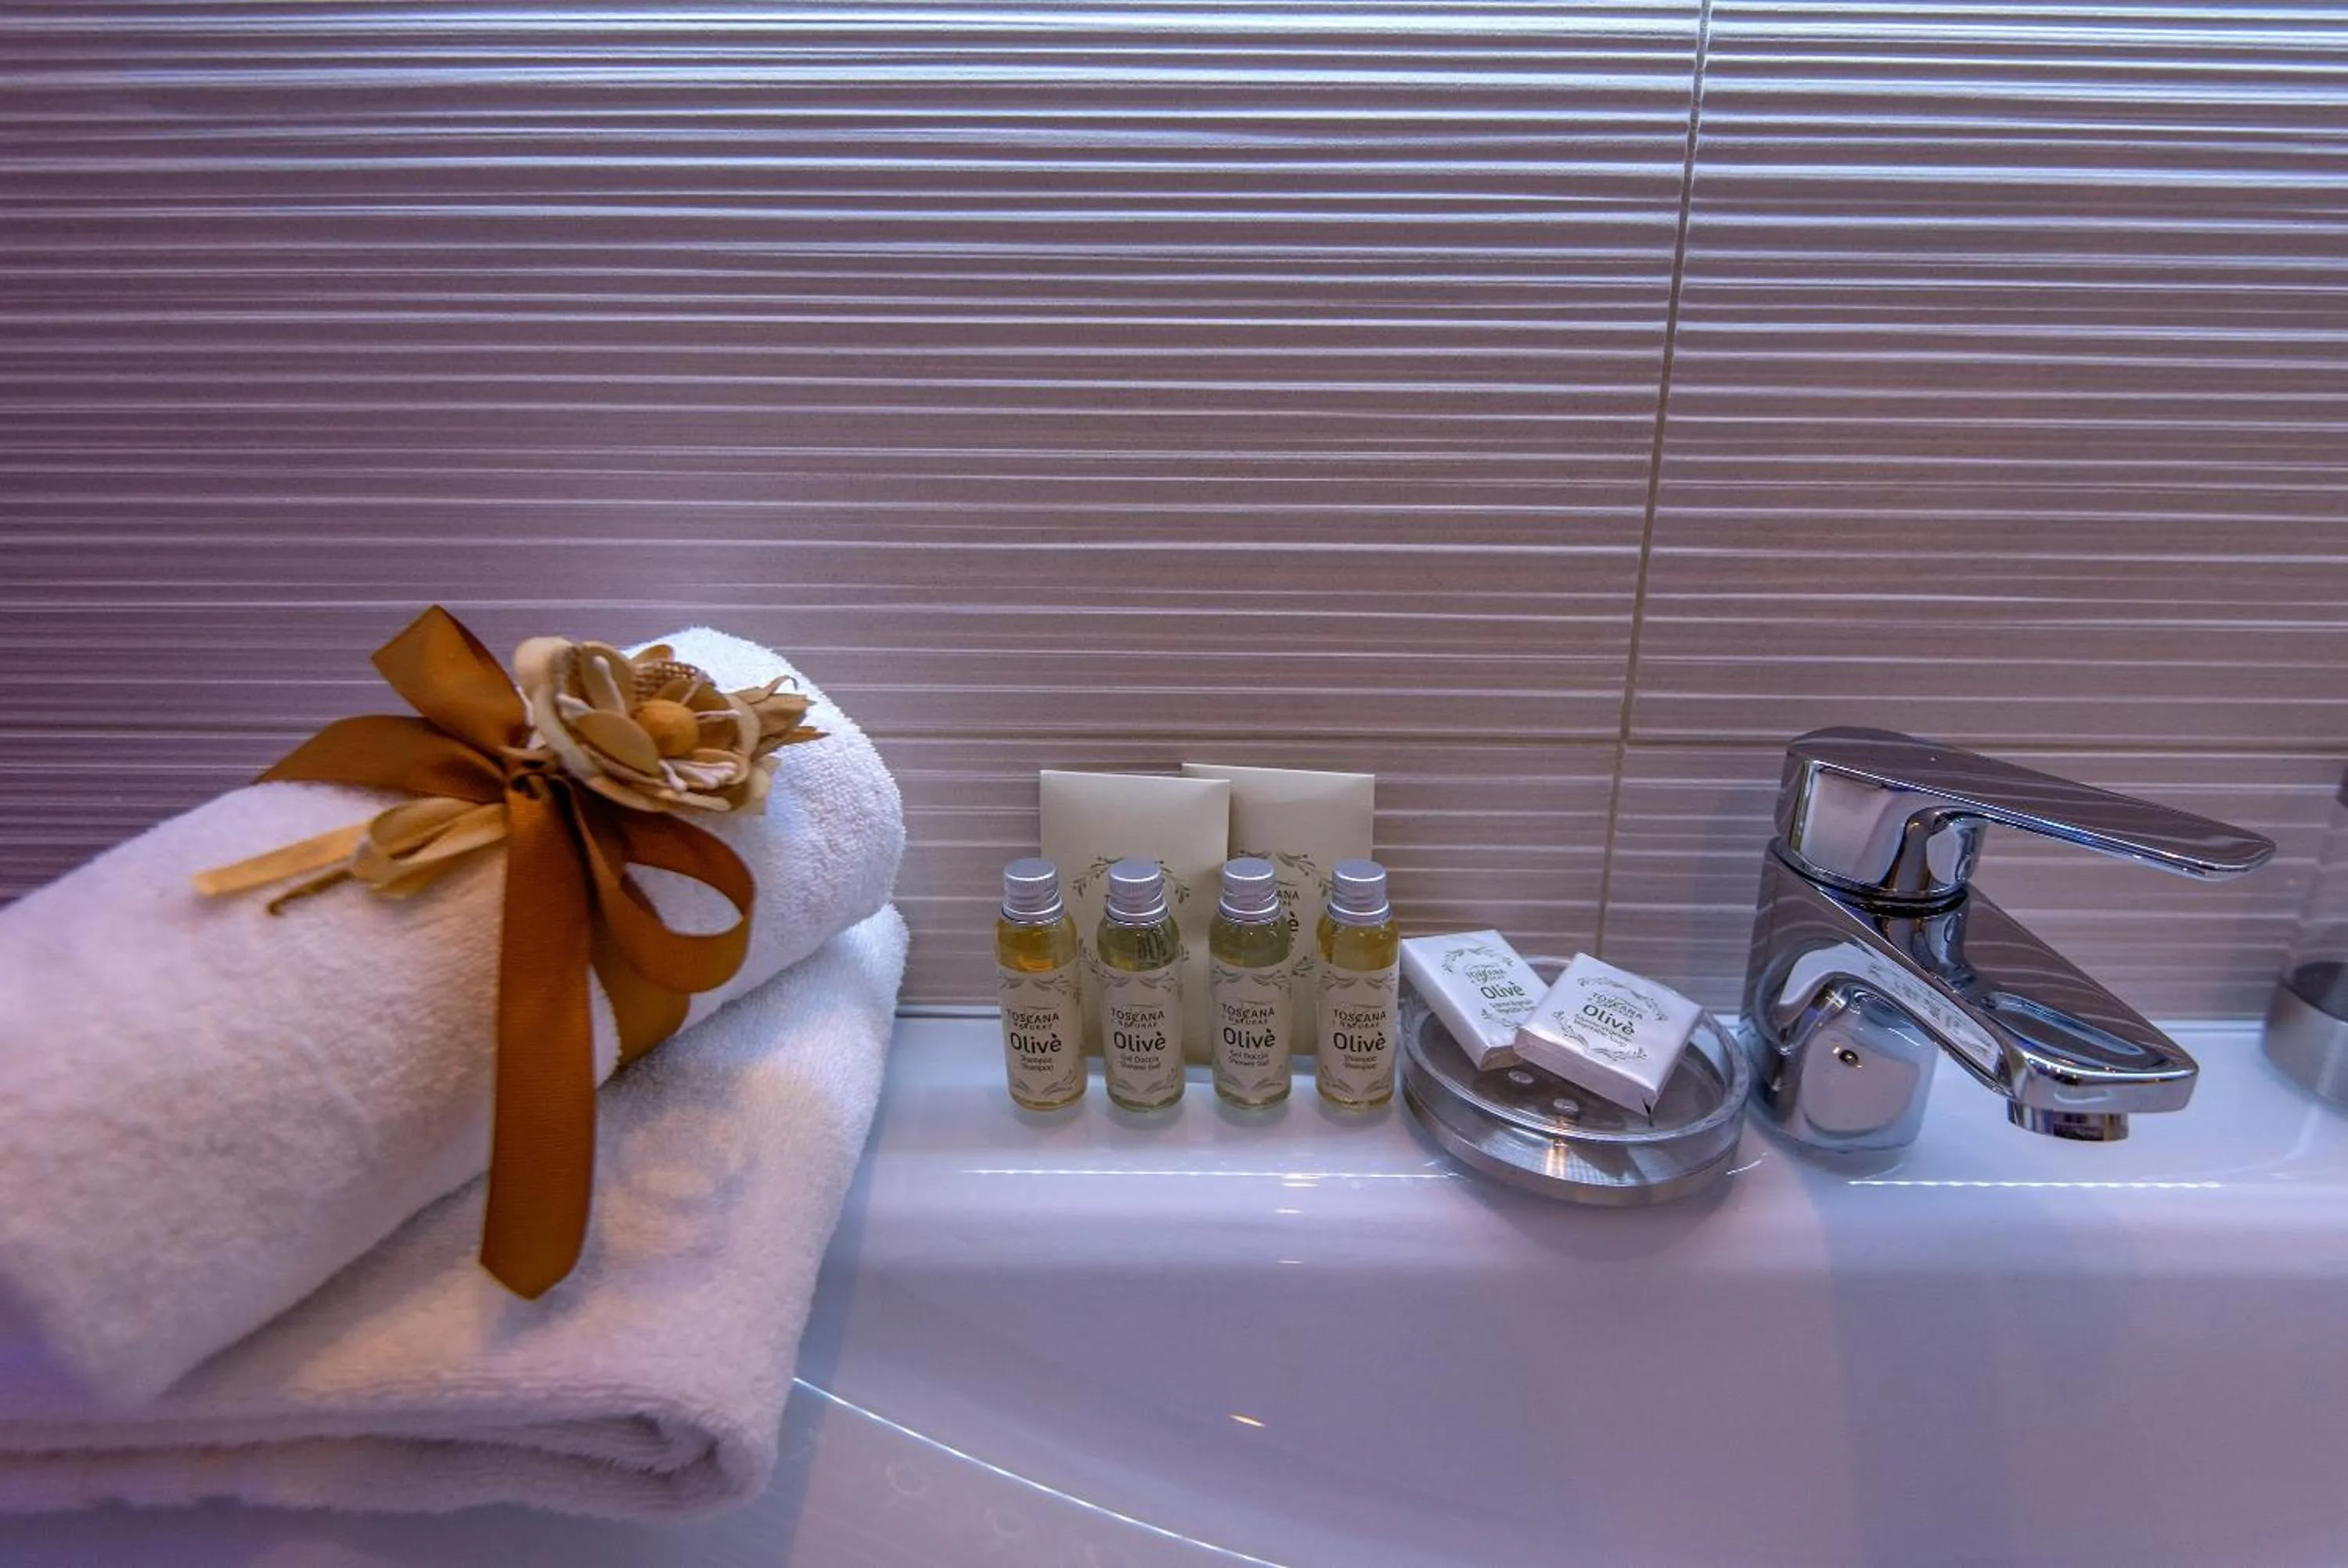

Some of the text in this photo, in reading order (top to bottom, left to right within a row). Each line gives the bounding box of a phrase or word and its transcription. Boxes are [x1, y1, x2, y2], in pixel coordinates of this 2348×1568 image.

[1480, 980, 1525, 999] Olivè
[1007, 1009, 1059, 1023] TOSCANA
[1111, 1007, 1165, 1022] TOSCANA
[1221, 1003, 1275, 1018] TOSCANA
[1334, 1009, 1387, 1023] TOSCANA
[1583, 1004, 1635, 1035] Olivè
[1010, 1032, 1061, 1054] Olivè
[1114, 1030, 1165, 1052] Olivè
[1223, 1027, 1276, 1049] Olivè
[1333, 1031, 1386, 1052] Olivè
